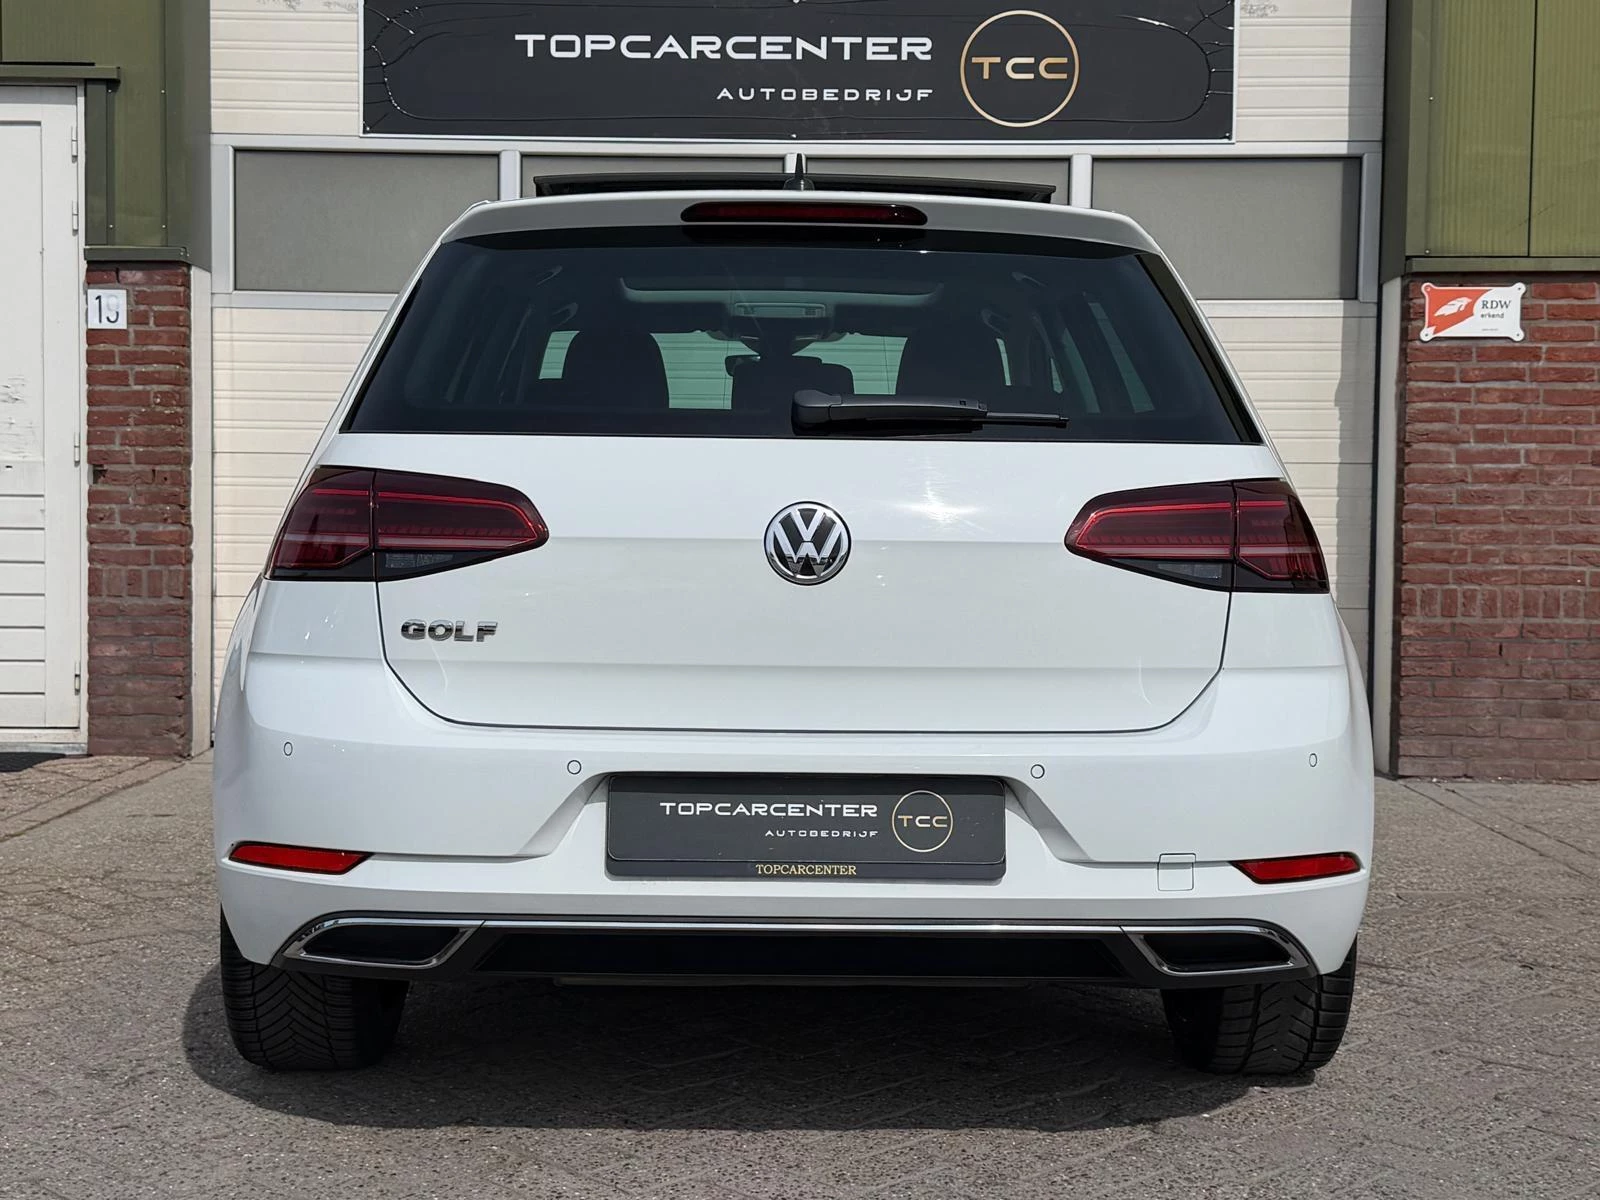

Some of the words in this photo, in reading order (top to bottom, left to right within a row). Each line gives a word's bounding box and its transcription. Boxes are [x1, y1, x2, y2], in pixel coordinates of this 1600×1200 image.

[514, 34, 933, 61] TOPCARCENTER
[971, 56, 1069, 80] TCC
[716, 87, 933, 102] AUTOBEDRIJF
[1481, 300, 1512, 310] RDW
[401, 619, 498, 642] GOLF
[659, 801, 878, 818] TOPCARCENTER
[897, 814, 948, 828] TCC
[764, 829, 879, 838] AUTOBEDRIJF
[755, 863, 857, 876] TOPCARCENTER
